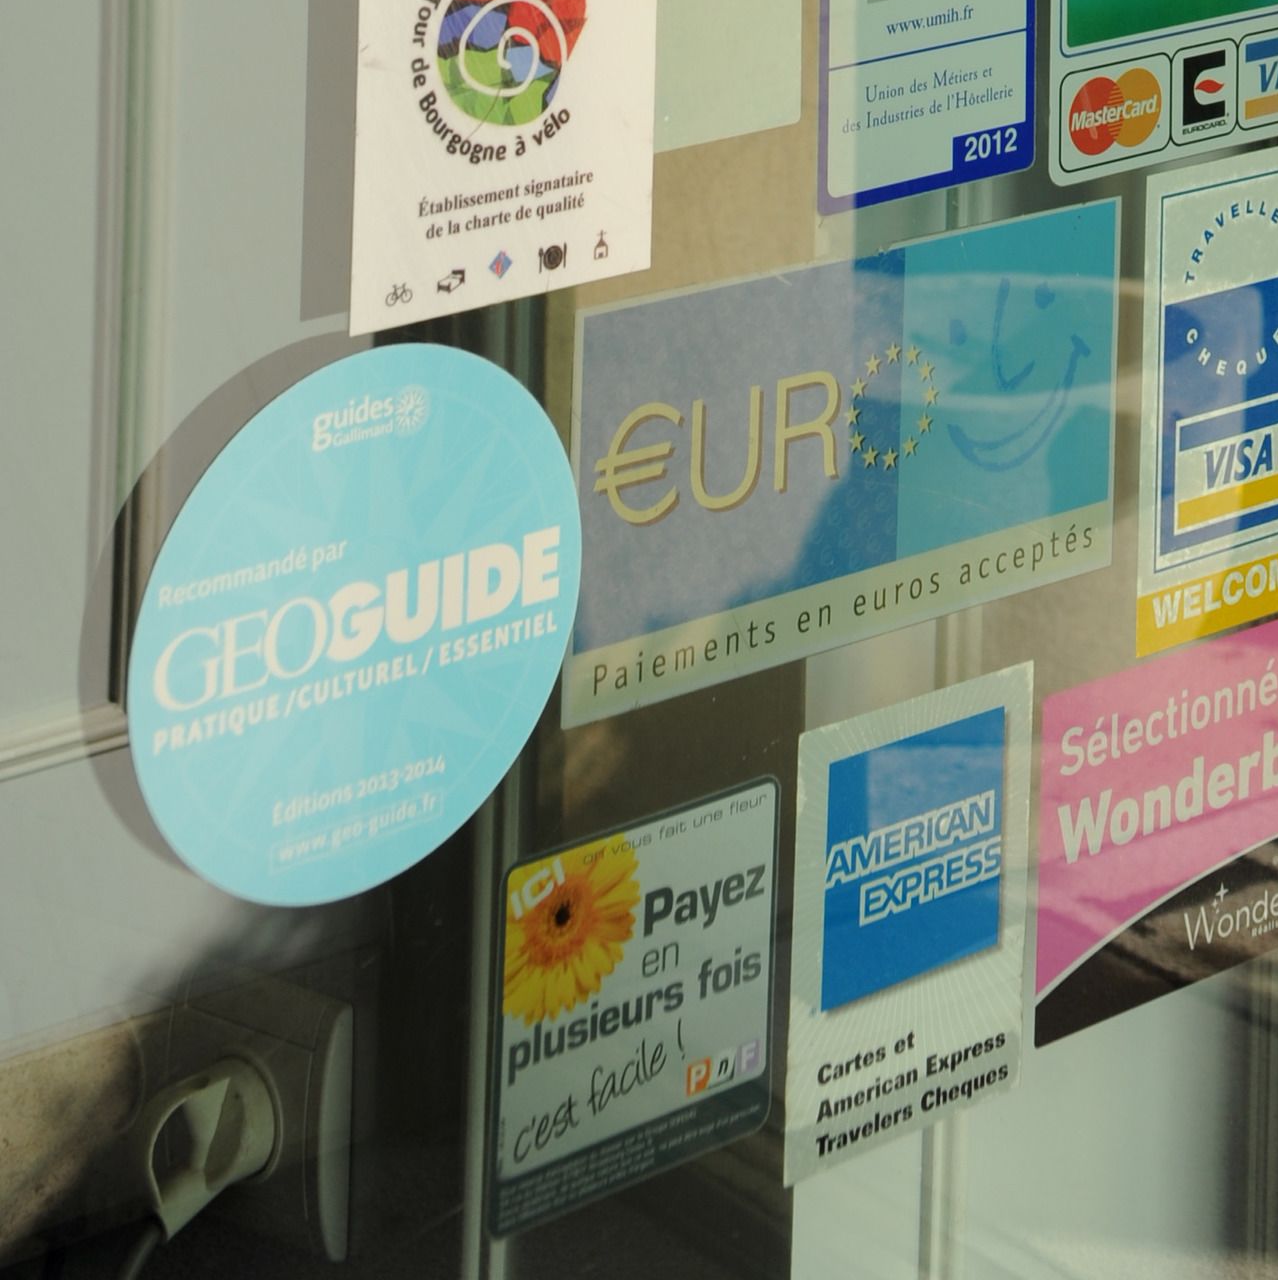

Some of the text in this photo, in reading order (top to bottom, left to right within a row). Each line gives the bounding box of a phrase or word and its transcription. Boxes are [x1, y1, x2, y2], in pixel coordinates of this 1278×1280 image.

[886, 4, 975, 35] www.umih.fr
[842, 99, 942, 134] des Industries de
[865, 68, 978, 103] Union des Métiers
[419, 90, 508, 165] Bourgogne
[532, 105, 571, 147] vélo
[964, 127, 1018, 163] 2012
[418, 170, 594, 218] Établissement signataire
[426, 192, 585, 240] de la charte de qualité
[1204, 433, 1274, 489] VISA
[158, 540, 348, 609] Recommandé par
[591, 523, 1094, 697] Paiements en euros acceptés
[152, 526, 561, 713] GEOGUIDE
[152, 610, 558, 756] PRATIQUE ESSENTIEL
[1059, 657, 1278, 777] Sélectionné
[826, 790, 996, 891] AMERICAN
[643, 863, 767, 939] Payez
[859, 836, 1001, 928] EXPRESS
[642, 941, 680, 979] en
[507, 949, 762, 1088] plusieurs fois
[815, 1032, 1007, 1125] American Express
[816, 1031, 915, 1085] Cartes et
[815, 1062, 1009, 1158] Travelers Cheques
